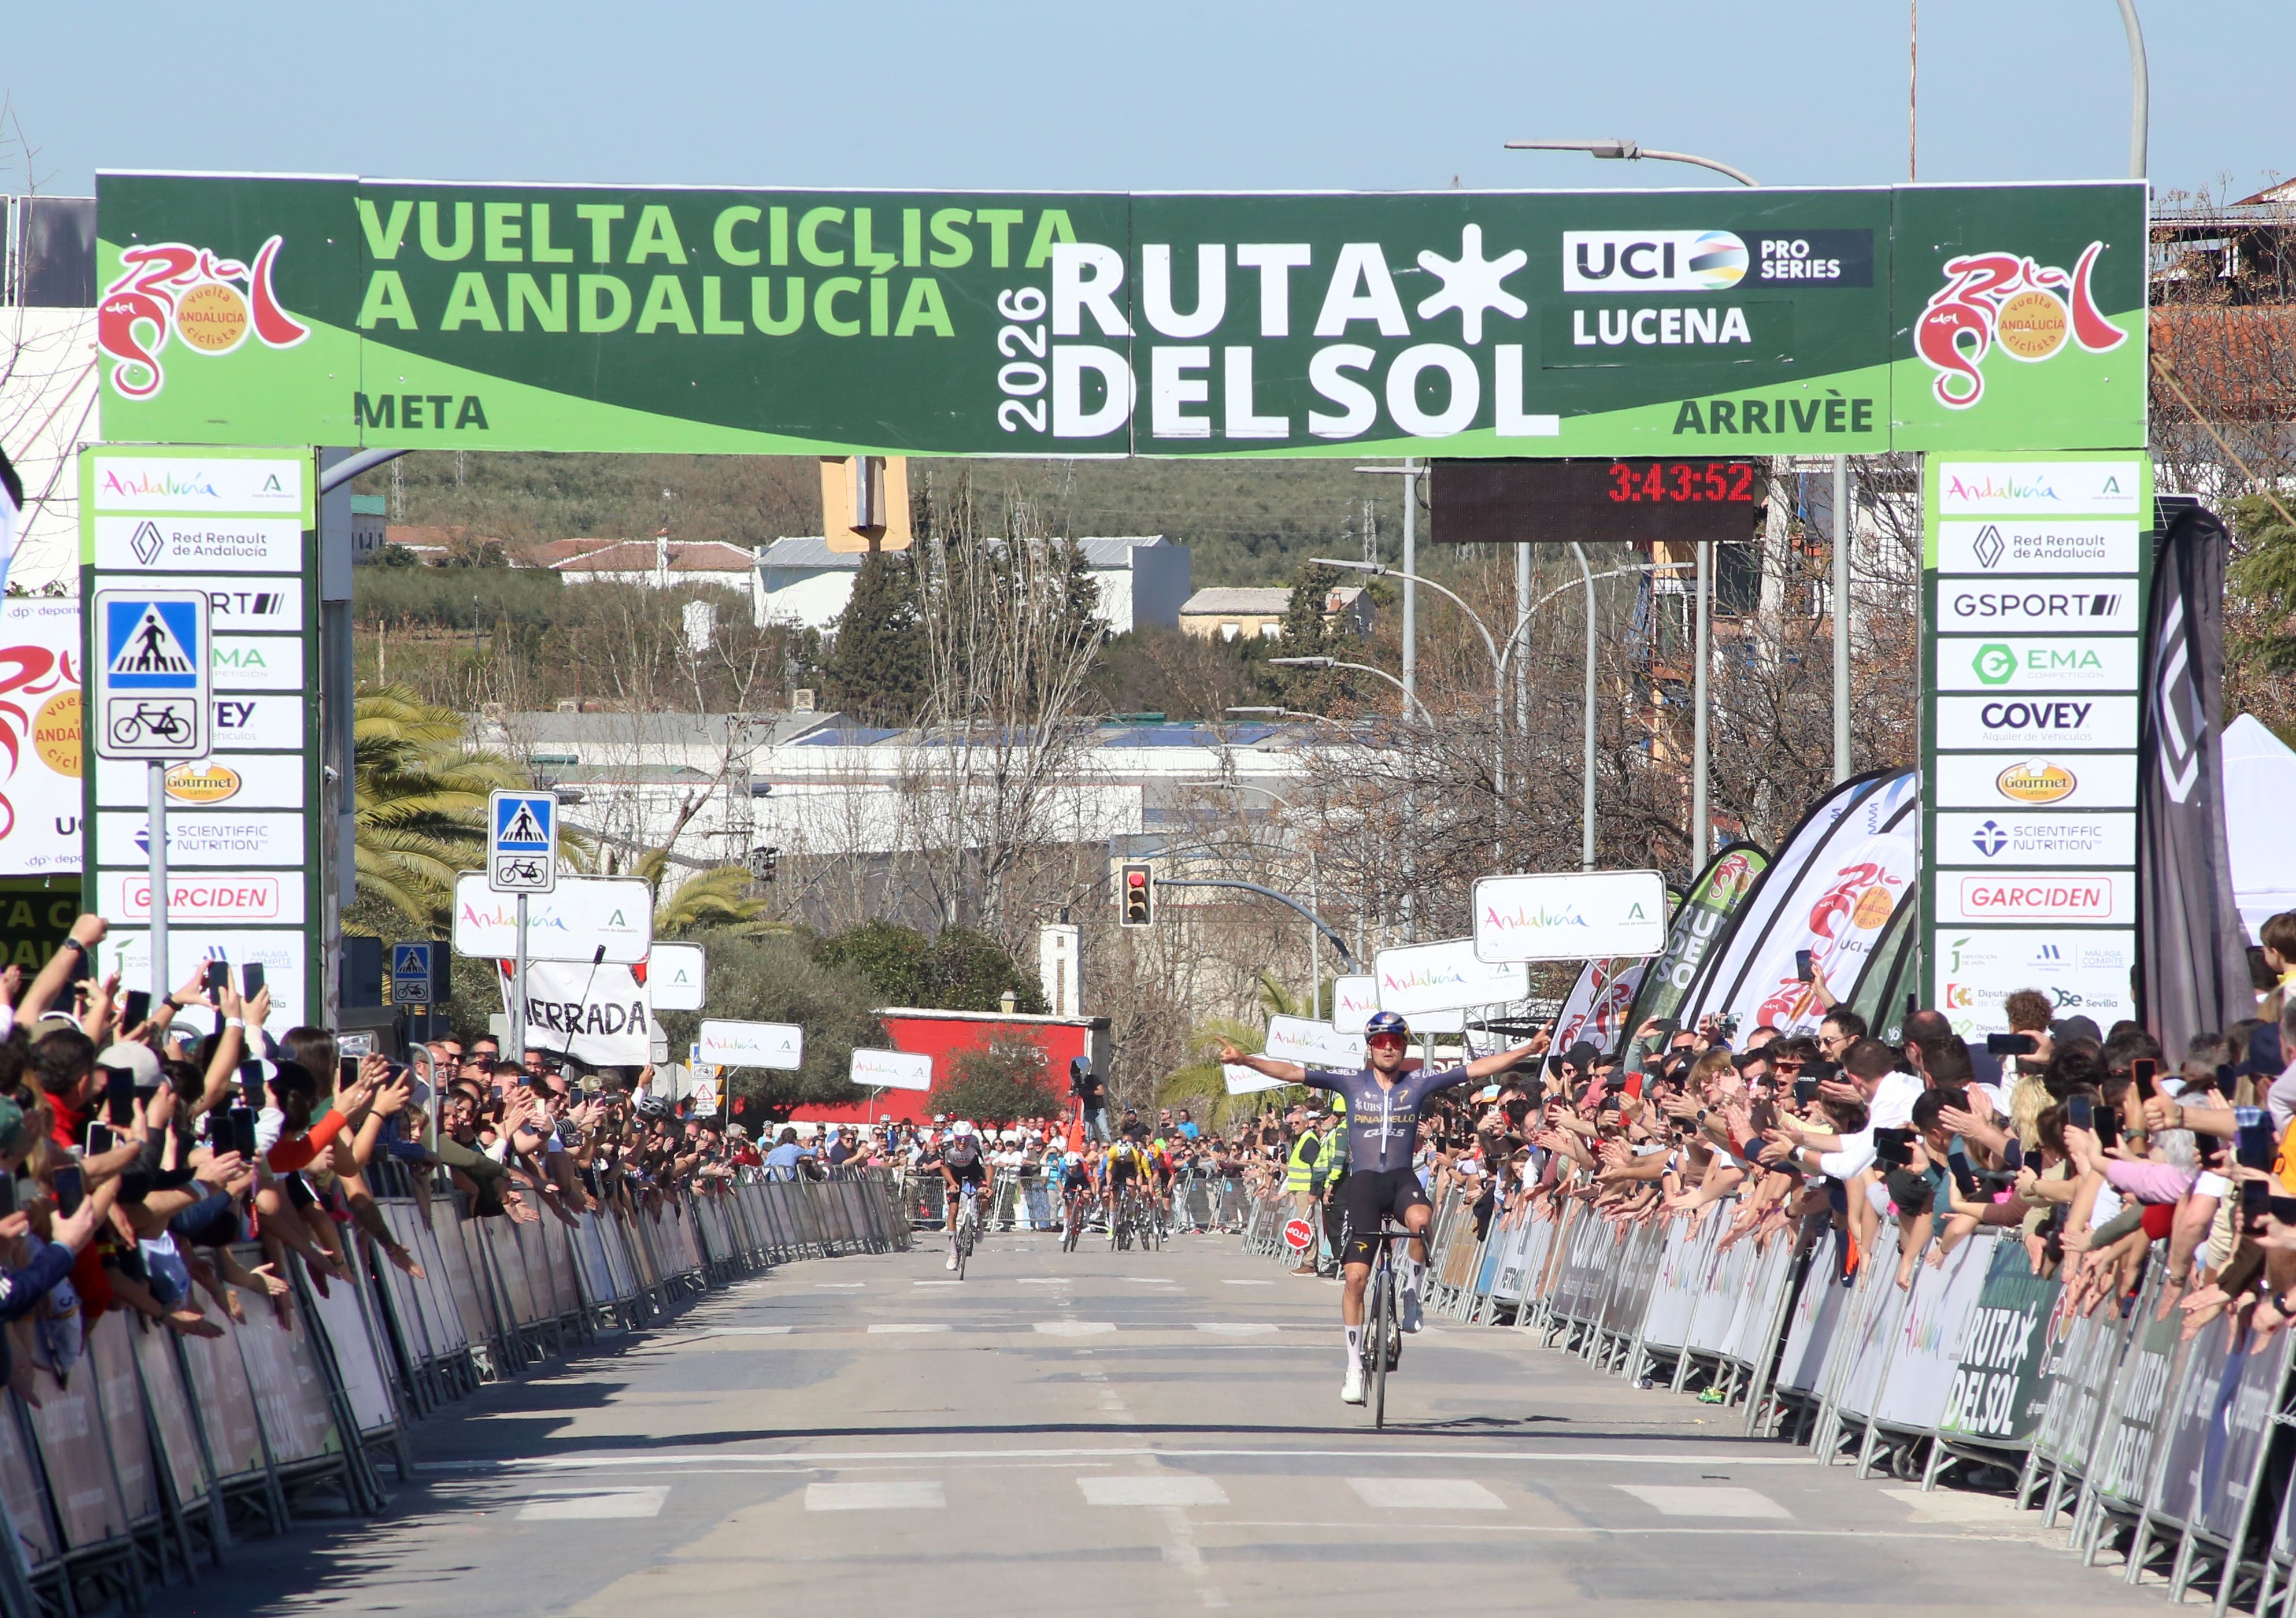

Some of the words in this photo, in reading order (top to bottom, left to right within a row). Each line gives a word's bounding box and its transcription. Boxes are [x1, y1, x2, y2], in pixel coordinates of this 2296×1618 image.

[354, 197, 688, 264] VUELTA
[713, 205, 1086, 268] CICLISTA
[1761, 239, 1809, 260] PRO
[1576, 242, 1675, 280] UCI
[1761, 258, 1841, 279] SERIES
[187, 286, 231, 305] vuelta
[355, 271, 419, 331] A
[440, 259, 955, 337] ANDALUCÍA
[1053, 242, 1411, 338] RUTA
[105, 302, 136, 314] del
[2009, 294, 2053, 312] vuelta
[179, 309, 246, 324] ANDALUCÍA
[1930, 313, 1960, 326] del
[1999, 317, 2065, 331] ANDALUCÍA
[187, 326, 238, 345] ciclista
[1573, 308, 1752, 346] LUCENA
[2008, 334, 2058, 353] ciclista
[997, 286, 1047, 433] 2026
[353, 391, 489, 431] META
[1672, 390, 1873, 435] ARRIVÈE
[102, 469, 222, 498] Andalucía
[1609, 462, 1753, 503] 3:43:52
[1947, 475, 2062, 502] Andalucía
[172, 532, 201, 543] Red
[206, 532, 267, 545] Renault
[2013, 535, 2042, 546] Red
[2046, 535, 2105, 546] Renault
[172, 545, 191, 556] de
[194, 545, 268, 557] Andalucía
[2013, 547, 2031, 558] de
[2034, 547, 2106, 559] Andalucía
[1954, 594, 2090, 617] GSPORT
[212, 648, 266, 668] MA
[2027, 650, 2104, 669] EMA
[214, 670, 269, 678] PETICIÓN
[2027, 671, 2105, 679] COMPETICIÓN
[1981, 702, 2093, 729] COVEY
[212, 731, 258, 741] ehículos
[1982, 732, 2022, 743] Alquiler
[2025, 732, 2038, 742] de
[2040, 731, 2093, 742] Vehículos
[167, 776, 232, 788] Gourmet
[2005, 776, 2068, 788] Gourmet
[177, 825, 269, 837] SCIENTIFFIC
[2013, 825, 2102, 837] SCIENTIFFIC
[135, 888, 268, 907] GRCIDEN
[1971, 887, 2101, 907] GARCIDEN
[1483, 904, 1591, 931] Andalucía
[251, 950, 290, 958] MÁLAGA
[1839, 939, 1862, 953] UCI
[2085, 949, 2121, 957] MÁLAGA
[2082, 957, 2125, 965] COMPITE
[1383, 965, 1468, 992] Andalucía
[2086, 999, 2119, 1008] Sevilla
[705, 1036, 761, 1051] Andalucía
[1273, 1030, 1328, 1051] Andalucía
[1421, 1069, 1442, 1079] UBS
[1363, 1102, 1383, 1112] UBS
[1354, 1114, 1416, 1124] PINAELLO
[1287, 1226, 1310, 1242] STOP
[1960, 1307, 2021, 1369] RUTA
